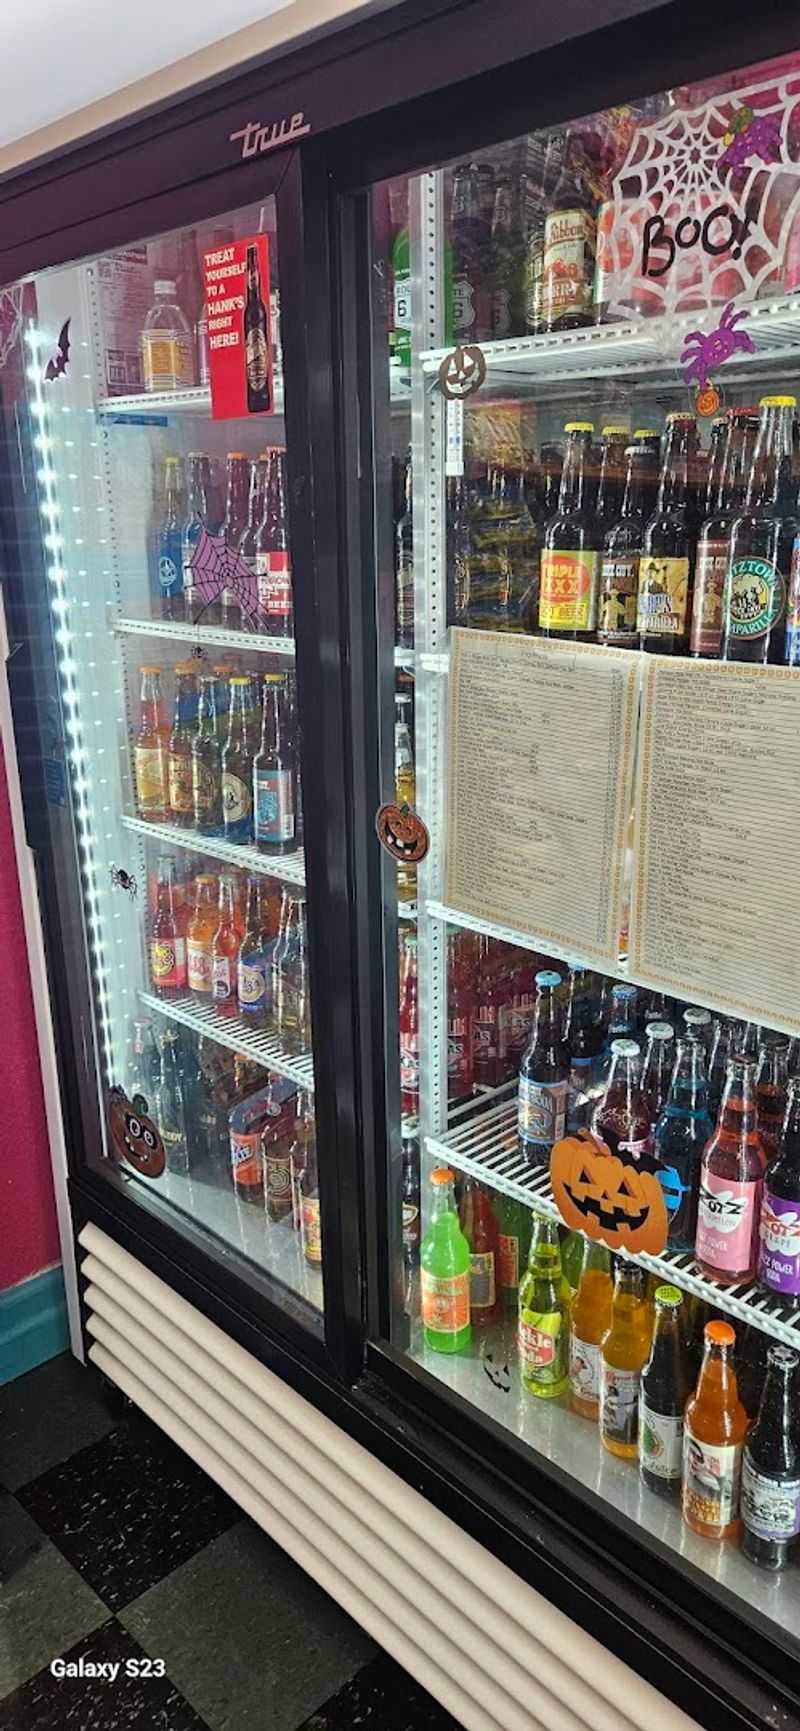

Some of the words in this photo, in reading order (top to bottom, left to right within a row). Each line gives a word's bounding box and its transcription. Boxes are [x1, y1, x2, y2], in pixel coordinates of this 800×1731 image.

[204, 247, 235, 267] TREAT
[205, 261, 247, 281] YOURSELF
[206, 285, 218, 297] TO
[219, 283, 226, 295] A
[208, 296, 245, 315] HANK'S
[208, 316, 233, 331] RIGHT
[209, 332, 240, 350] HERE!
